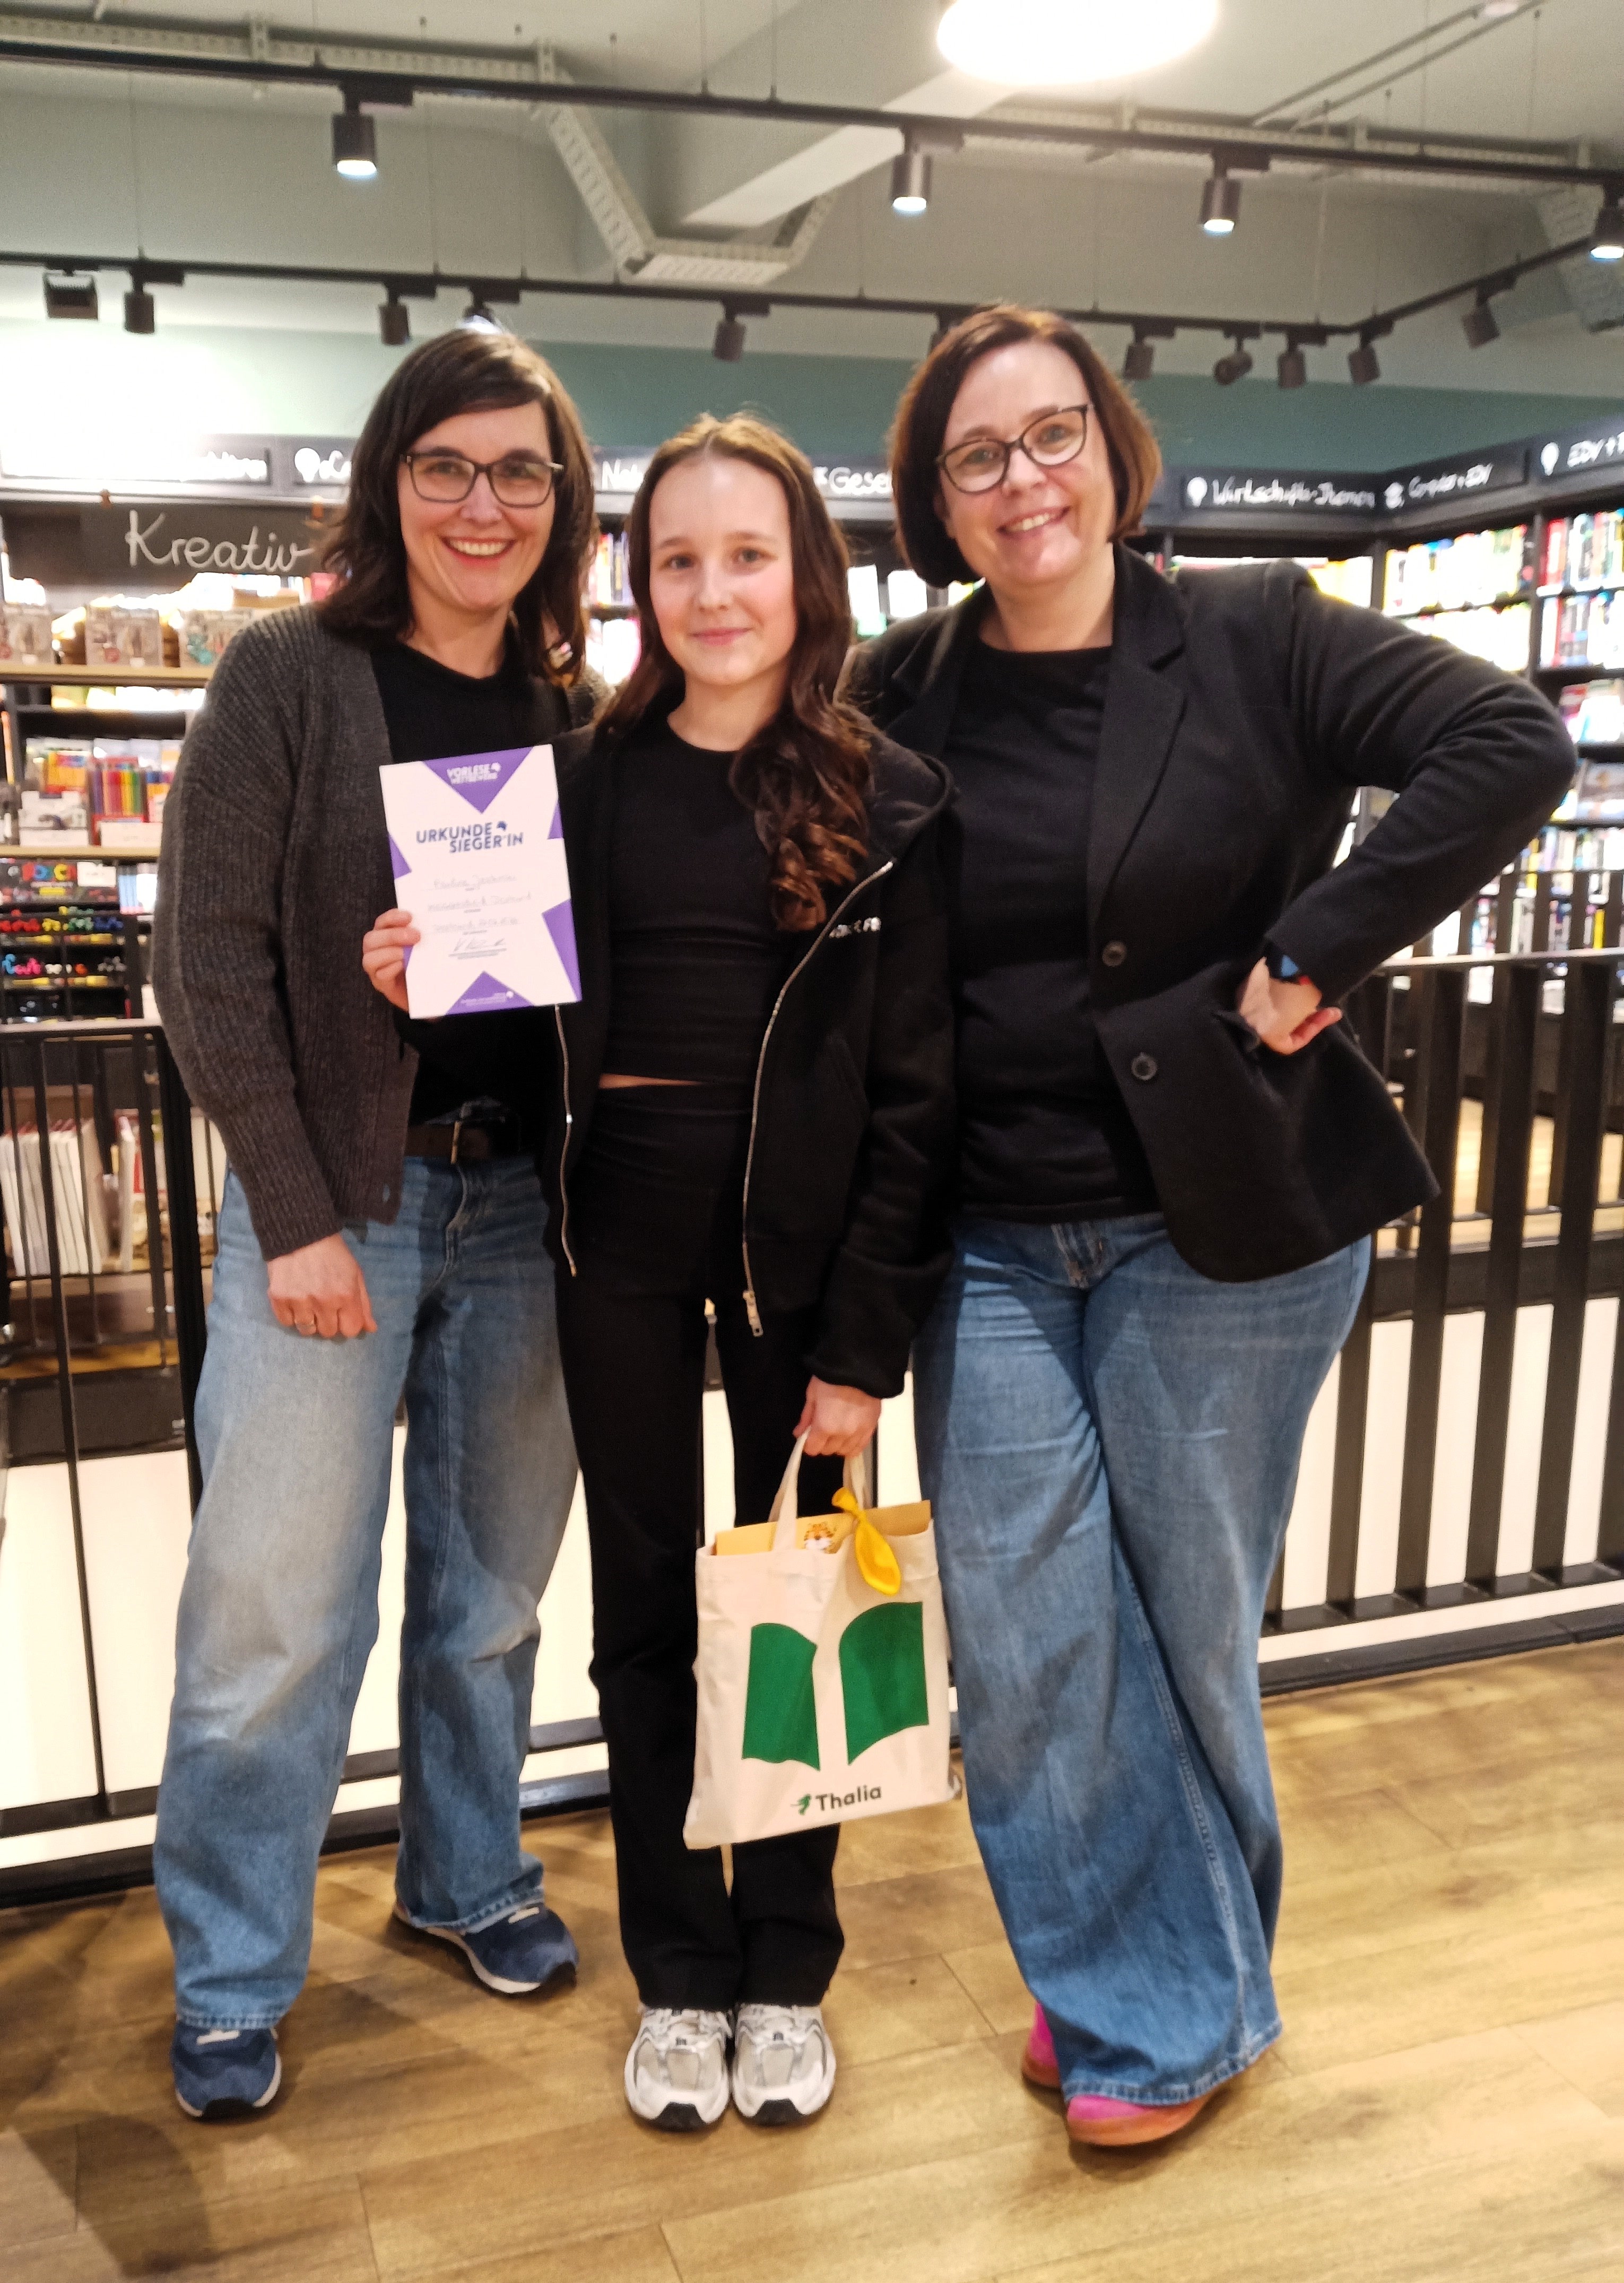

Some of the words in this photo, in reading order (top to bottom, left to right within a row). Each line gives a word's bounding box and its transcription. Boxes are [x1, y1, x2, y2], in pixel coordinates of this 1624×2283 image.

[124, 509, 314, 572] Kreativ
[416, 822, 493, 844] URKUNDE
[815, 1784, 882, 1811] Thalia
